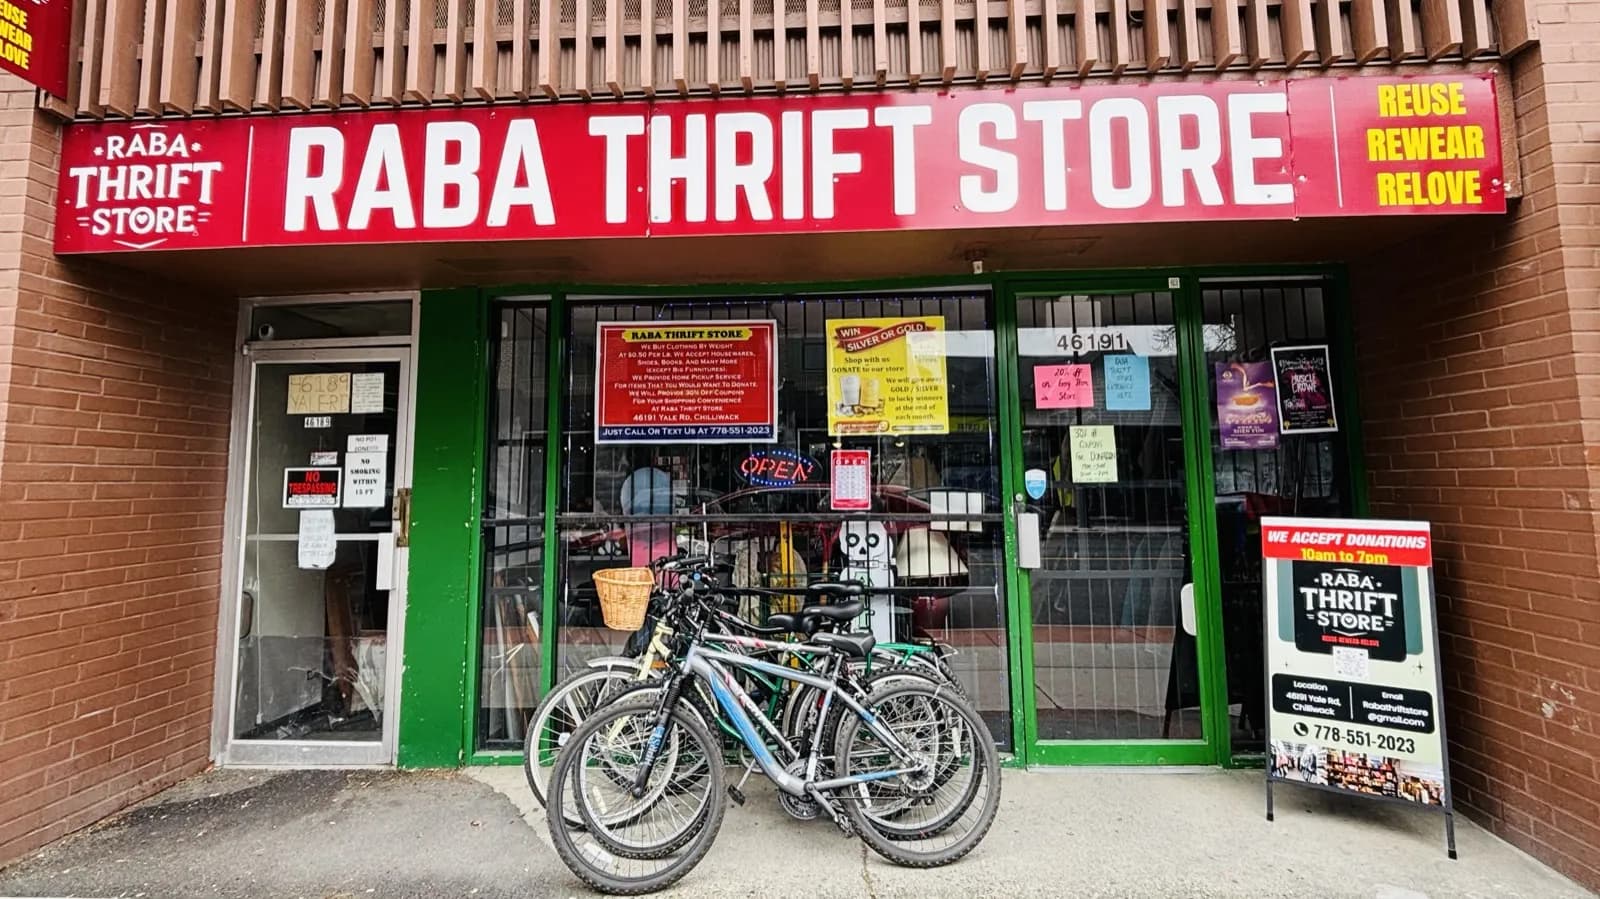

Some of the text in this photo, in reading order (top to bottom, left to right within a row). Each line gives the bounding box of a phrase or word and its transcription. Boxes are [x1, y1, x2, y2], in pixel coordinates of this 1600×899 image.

[1377, 82, 1467, 118] REUSE
[106, 132, 190, 160] RABA
[1367, 125, 1485, 162] REWEAR
[283, 92, 1296, 233] RABA THRIFT STORE
[69, 161, 223, 209] THRIFT
[1376, 170, 1483, 207] RELOVE
[92, 205, 197, 236] STORE
[632, 332, 663, 340] RABA
[840, 327, 861, 338] WIN
[847, 323, 924, 352] SILVER OR GOLD
[1057, 333, 1125, 351] 46191
[624, 428, 646, 436] CALL
[697, 427, 708, 435] AT
[305, 471, 321, 483] NO
[741, 456, 814, 482] OPEN
[288, 482, 337, 495] TRESPASSING
[1267, 530, 1428, 549] WE ACCEPT DONATIONS
[1301, 548, 1389, 564] 10am to 7pm
[1320, 572, 1375, 591] RABA
[1300, 587, 1398, 618] THRIFT
[1317, 610, 1385, 632] STORE
[1293, 681, 1328, 692] Location
[1308, 694, 1327, 704] Yale
[1292, 703, 1336, 716] Chilliwack
[1313, 724, 1416, 754] 778-551-2023
